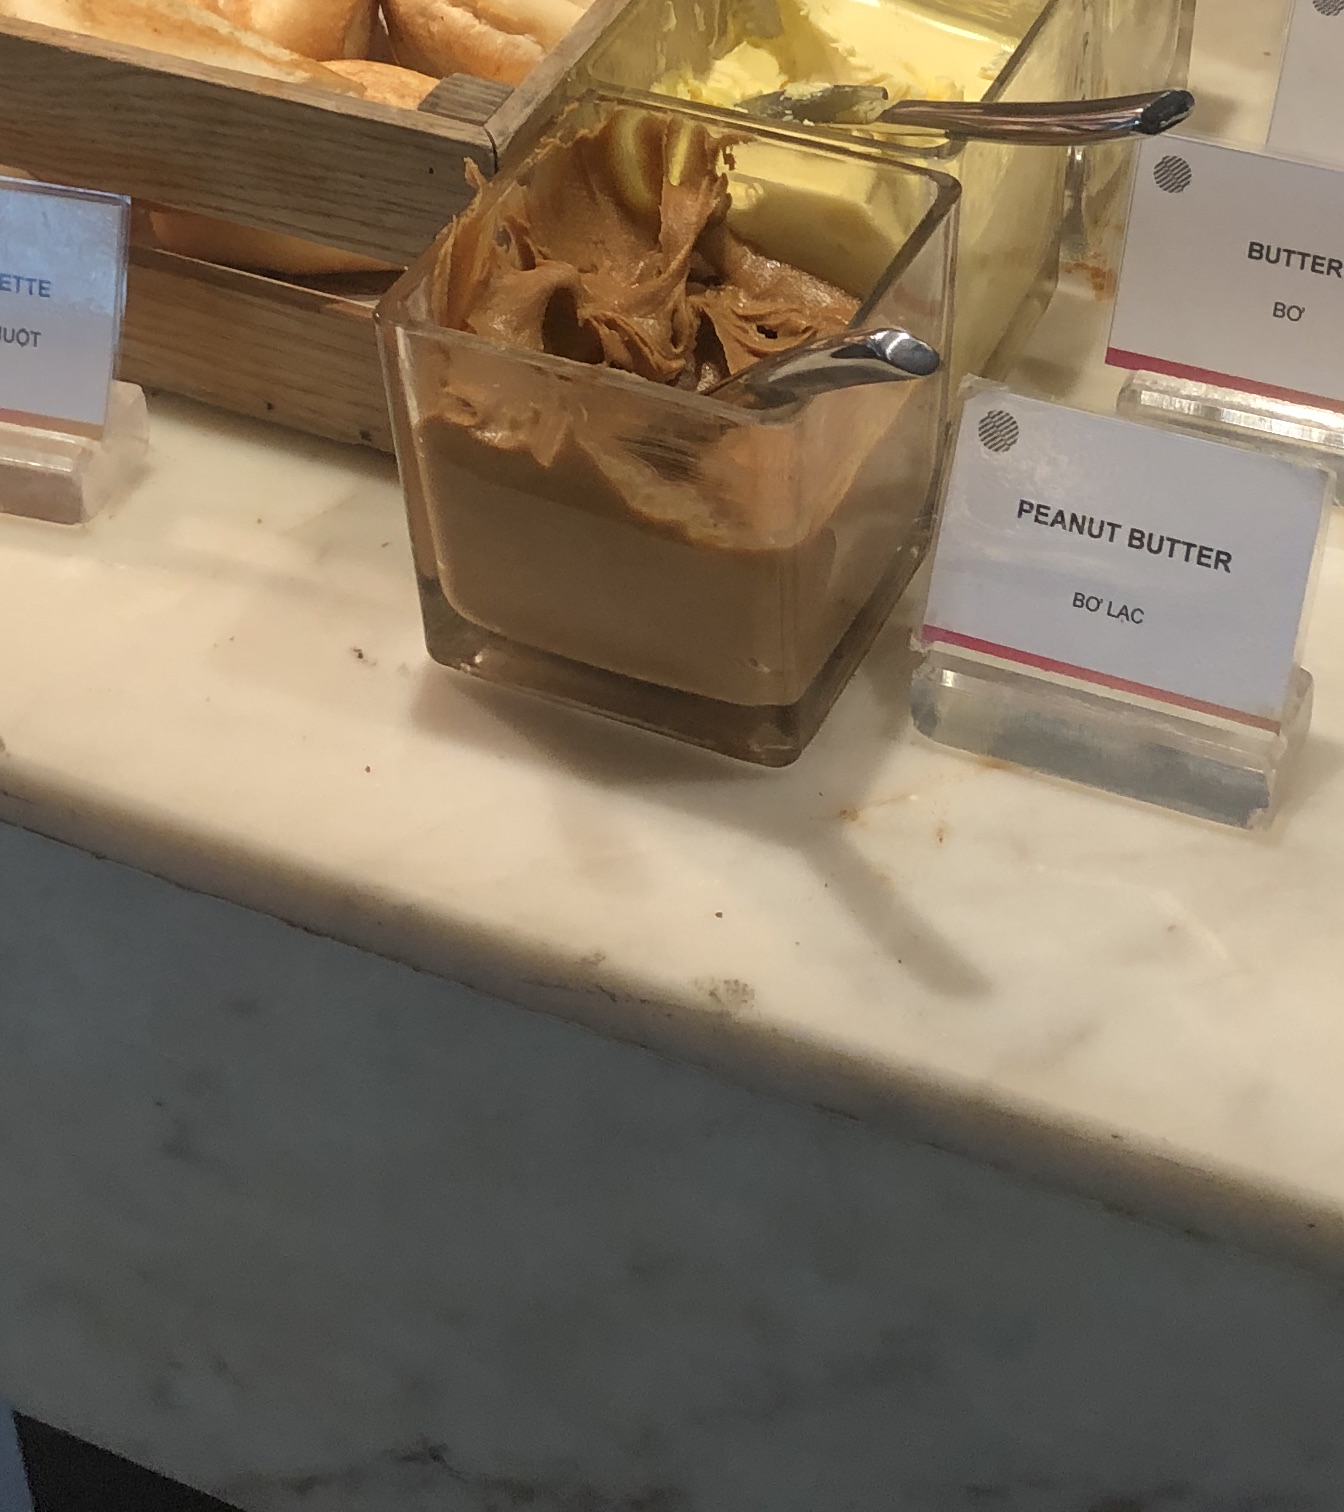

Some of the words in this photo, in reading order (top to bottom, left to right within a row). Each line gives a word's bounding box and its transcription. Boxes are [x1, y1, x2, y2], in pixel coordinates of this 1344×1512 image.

[1247, 241, 1344, 278] BUTTER
[1272, 301, 1305, 322] BƠ
[1017, 499, 1122, 543] PEANUT
[1127, 528, 1233, 573] BUTTER
[1073, 592, 1103, 612] BƠ
